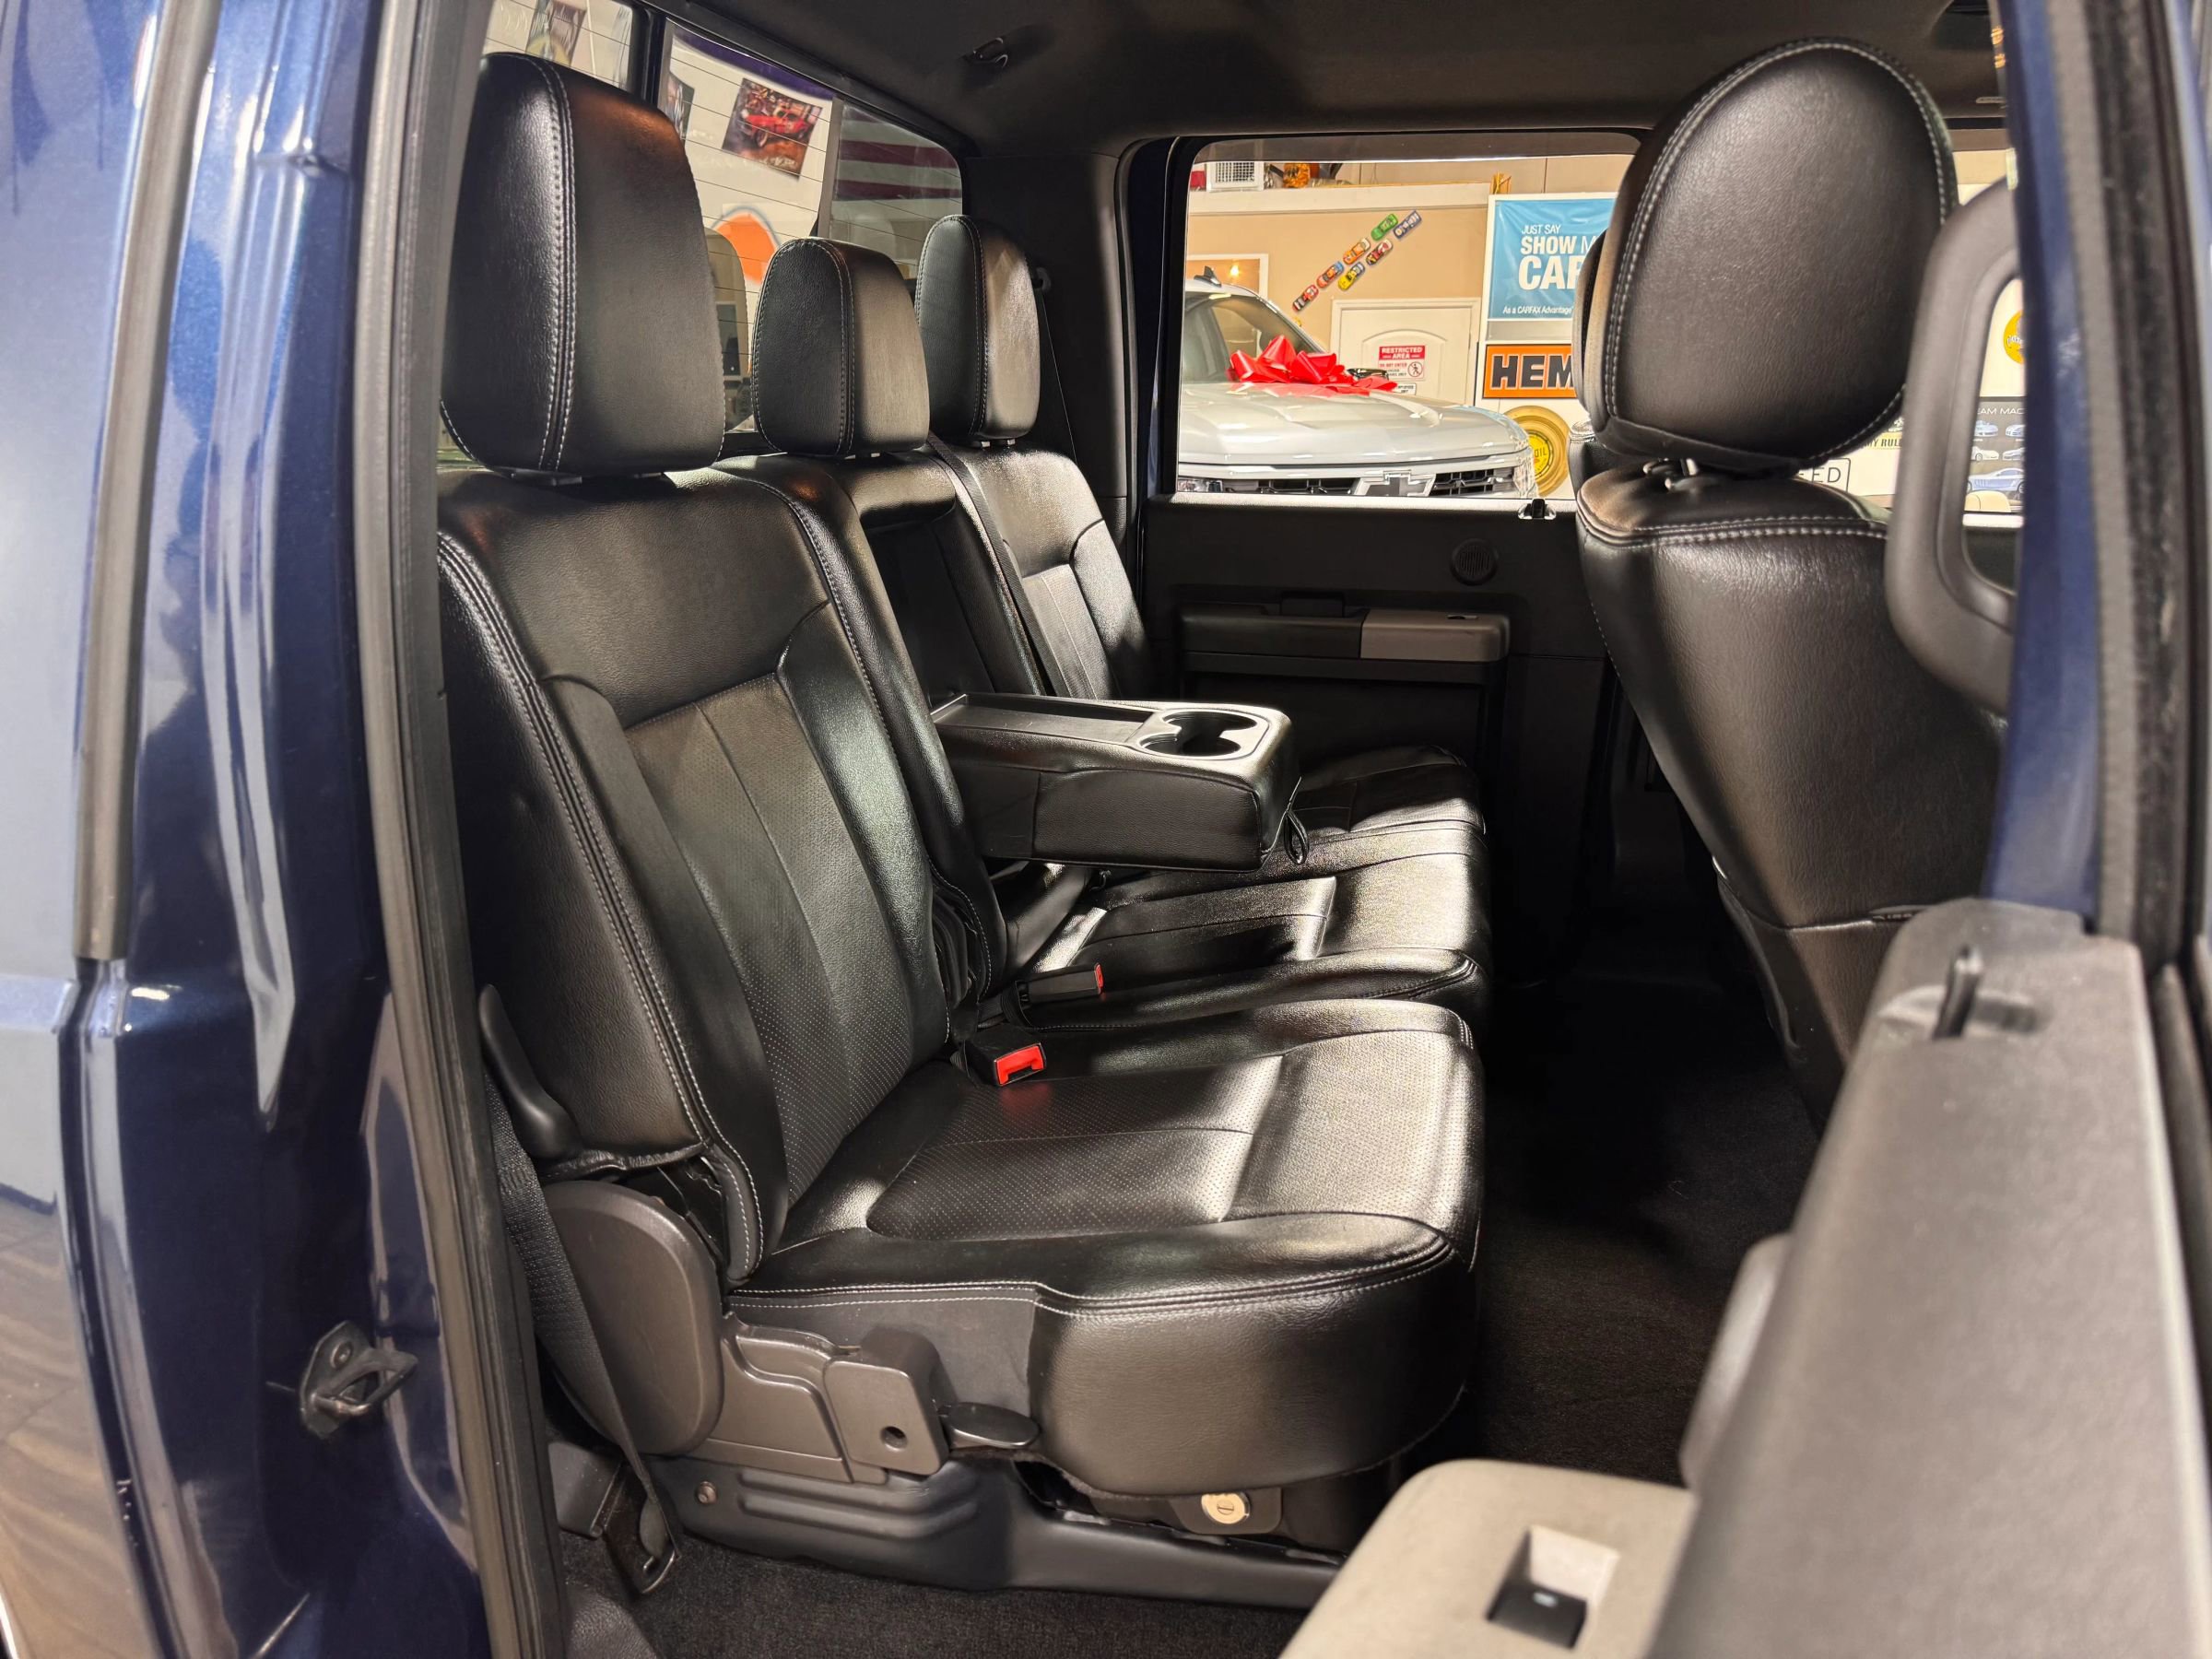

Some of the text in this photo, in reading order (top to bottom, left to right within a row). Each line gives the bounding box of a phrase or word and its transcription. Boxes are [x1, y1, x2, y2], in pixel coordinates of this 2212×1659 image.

[1521, 224, 1561, 234] JUST SAY
[1520, 235, 1577, 255] SHOW
[1503, 306, 1511, 314] As
[1517, 306, 1541, 314] CARFAX
[1881, 438, 1901, 447] RUL
[1799, 466, 1841, 483] ED
